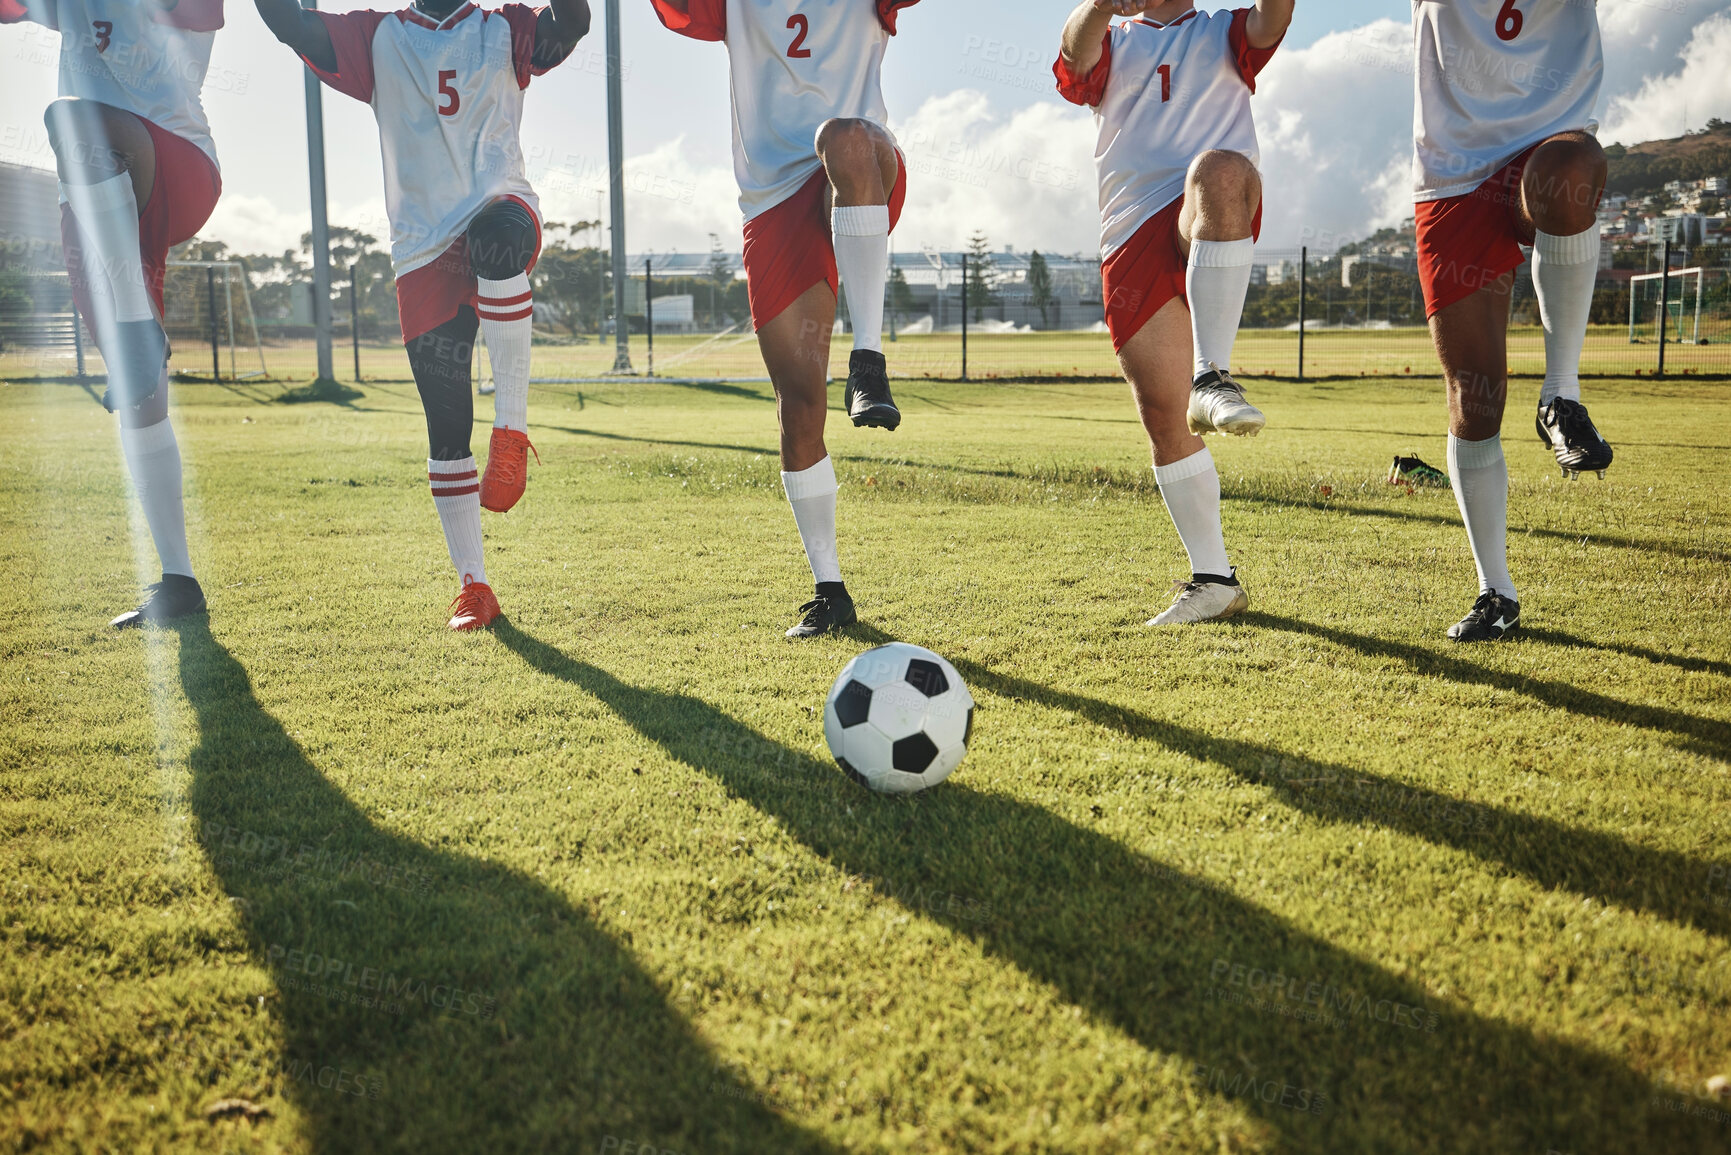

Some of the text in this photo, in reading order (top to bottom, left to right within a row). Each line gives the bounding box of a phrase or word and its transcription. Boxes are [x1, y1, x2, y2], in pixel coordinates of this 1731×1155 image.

[94, 21, 114, 53] 3
[786, 13, 812, 58] 2
[1495, 0, 1523, 41] 6
[438, 70, 460, 116] 5
[1157, 64, 1171, 103] 1
